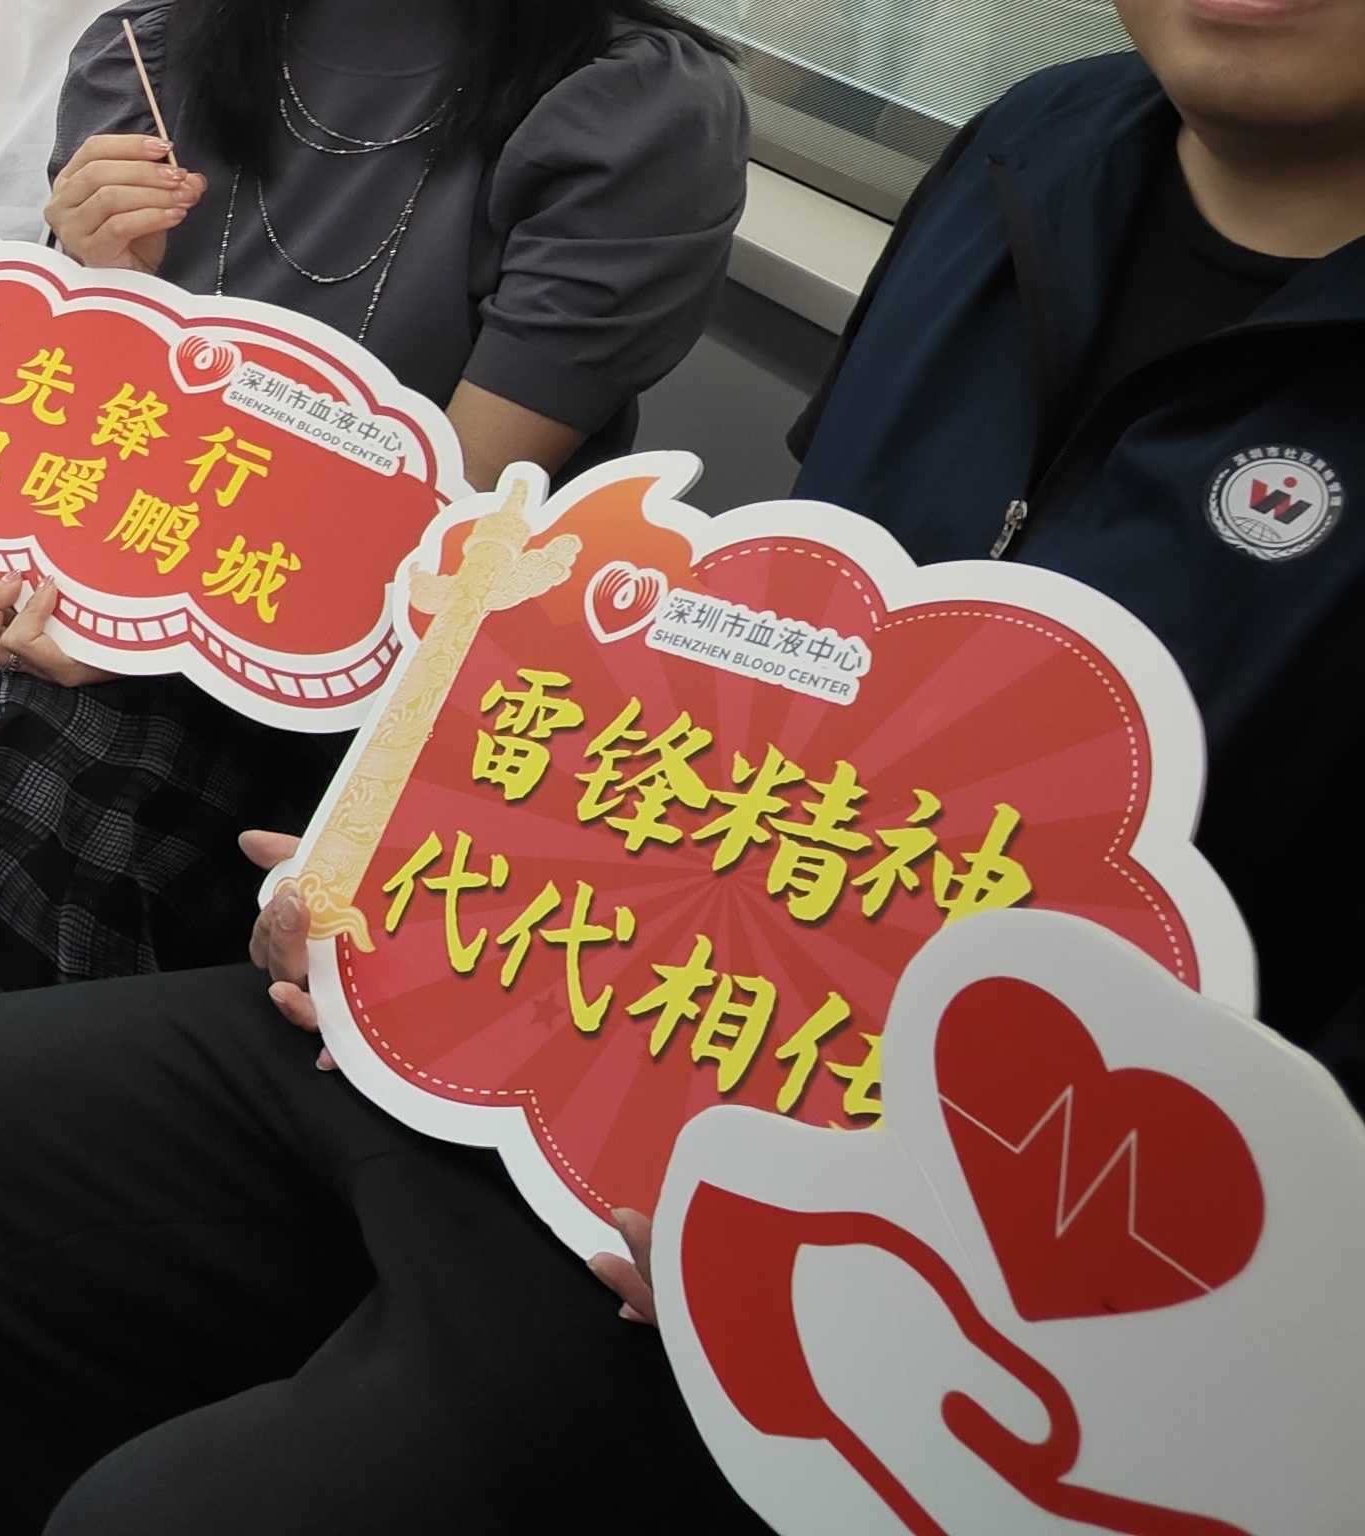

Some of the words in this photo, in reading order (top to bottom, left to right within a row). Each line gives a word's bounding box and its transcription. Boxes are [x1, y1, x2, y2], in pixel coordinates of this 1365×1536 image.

[228, 390, 296, 427] SHENZHEN
[296, 420, 341, 447] BLOOD
[342, 441, 393, 470] CENTER
[236, 366, 403, 453] 深圳市血液中心
[652, 628, 732, 662] SHENZHEN
[731, 652, 786, 678] BLOOD
[787, 667, 852, 697] CENTER
[662, 595, 863, 672] 深圳市血液中心
[468, 666, 1035, 926] 雷锋精神
